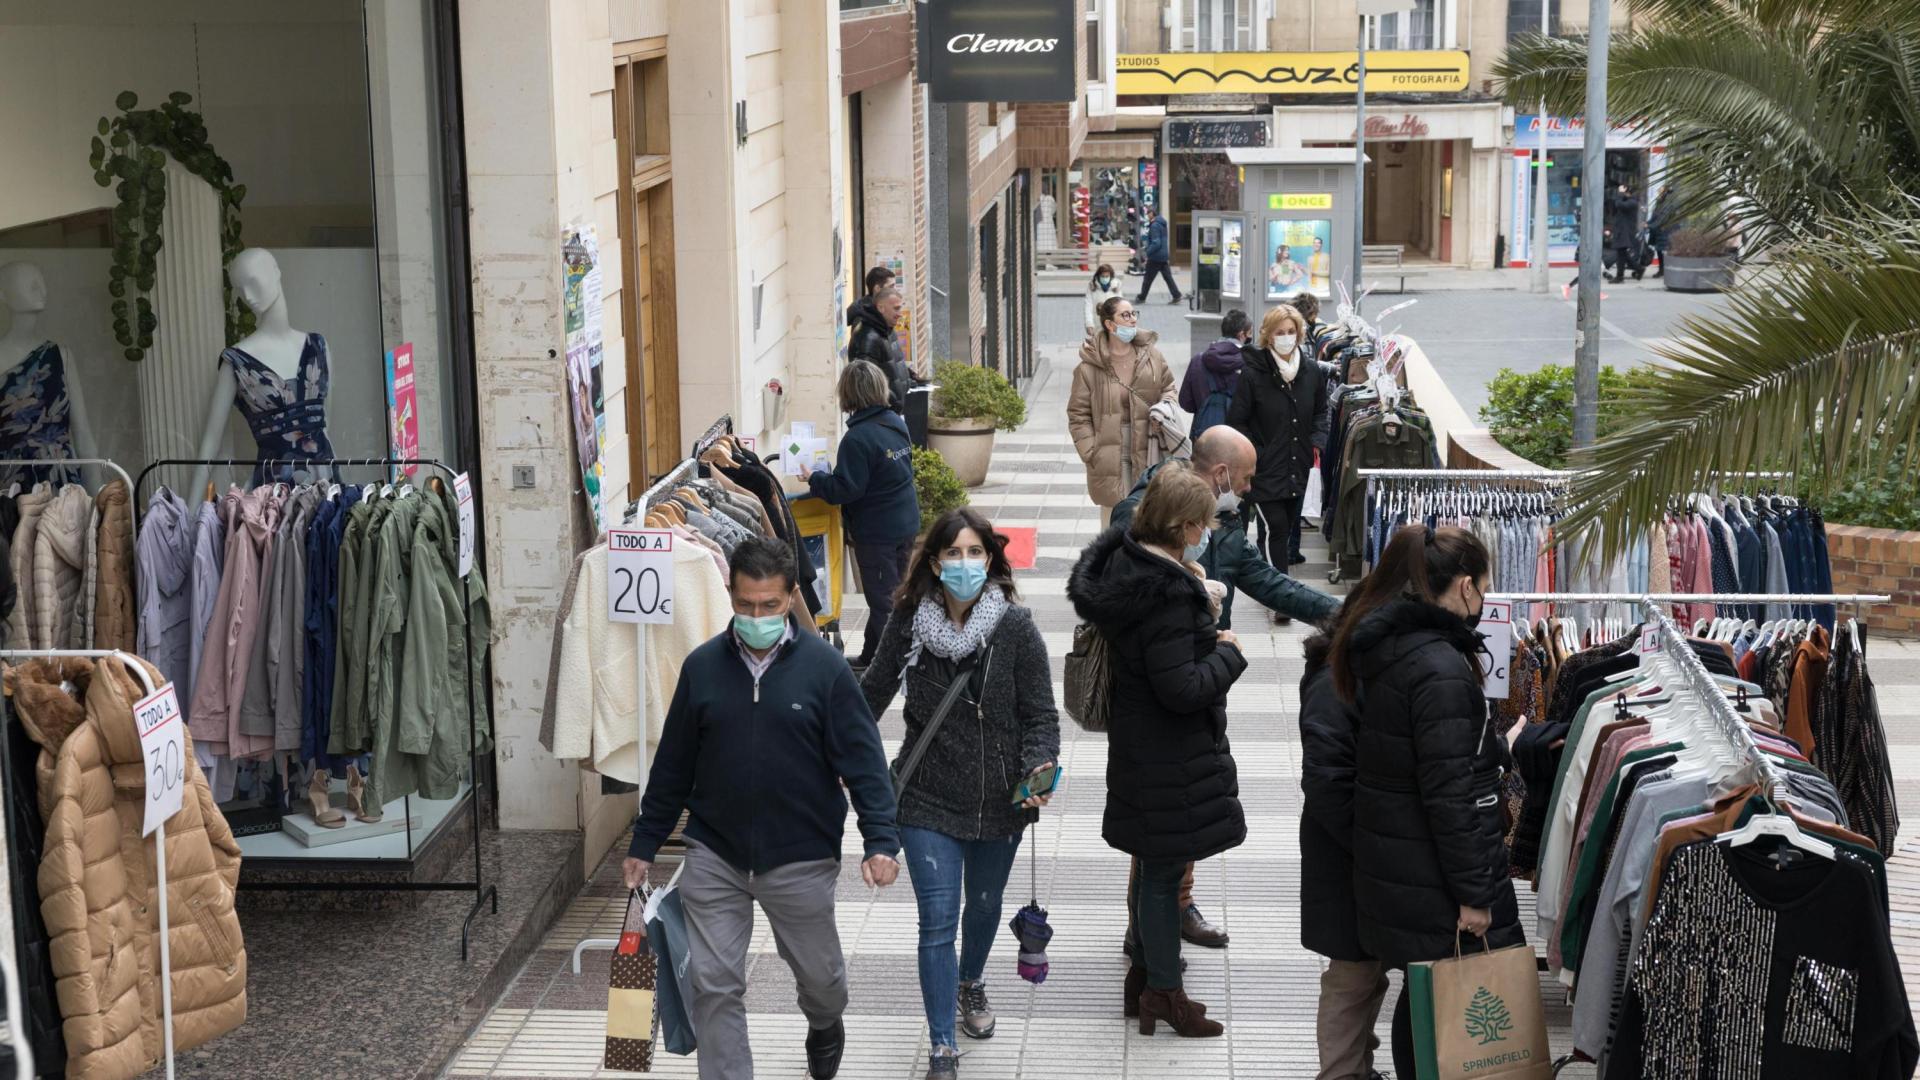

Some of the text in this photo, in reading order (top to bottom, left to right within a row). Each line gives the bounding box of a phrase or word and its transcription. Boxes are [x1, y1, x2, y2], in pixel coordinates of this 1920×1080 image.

[946, 33, 1059, 53] Clemos
[1392, 75, 1460, 84] FOTOGRAFIA
[1287, 196, 1326, 206] ONCE
[616, 534, 663, 549] TODO A
[614, 567, 671, 614] 20€
[1489, 607, 1500, 620] A
[140, 699, 172, 731] TODO A
[1462, 1049, 1530, 1072] SPRINGFIELD
